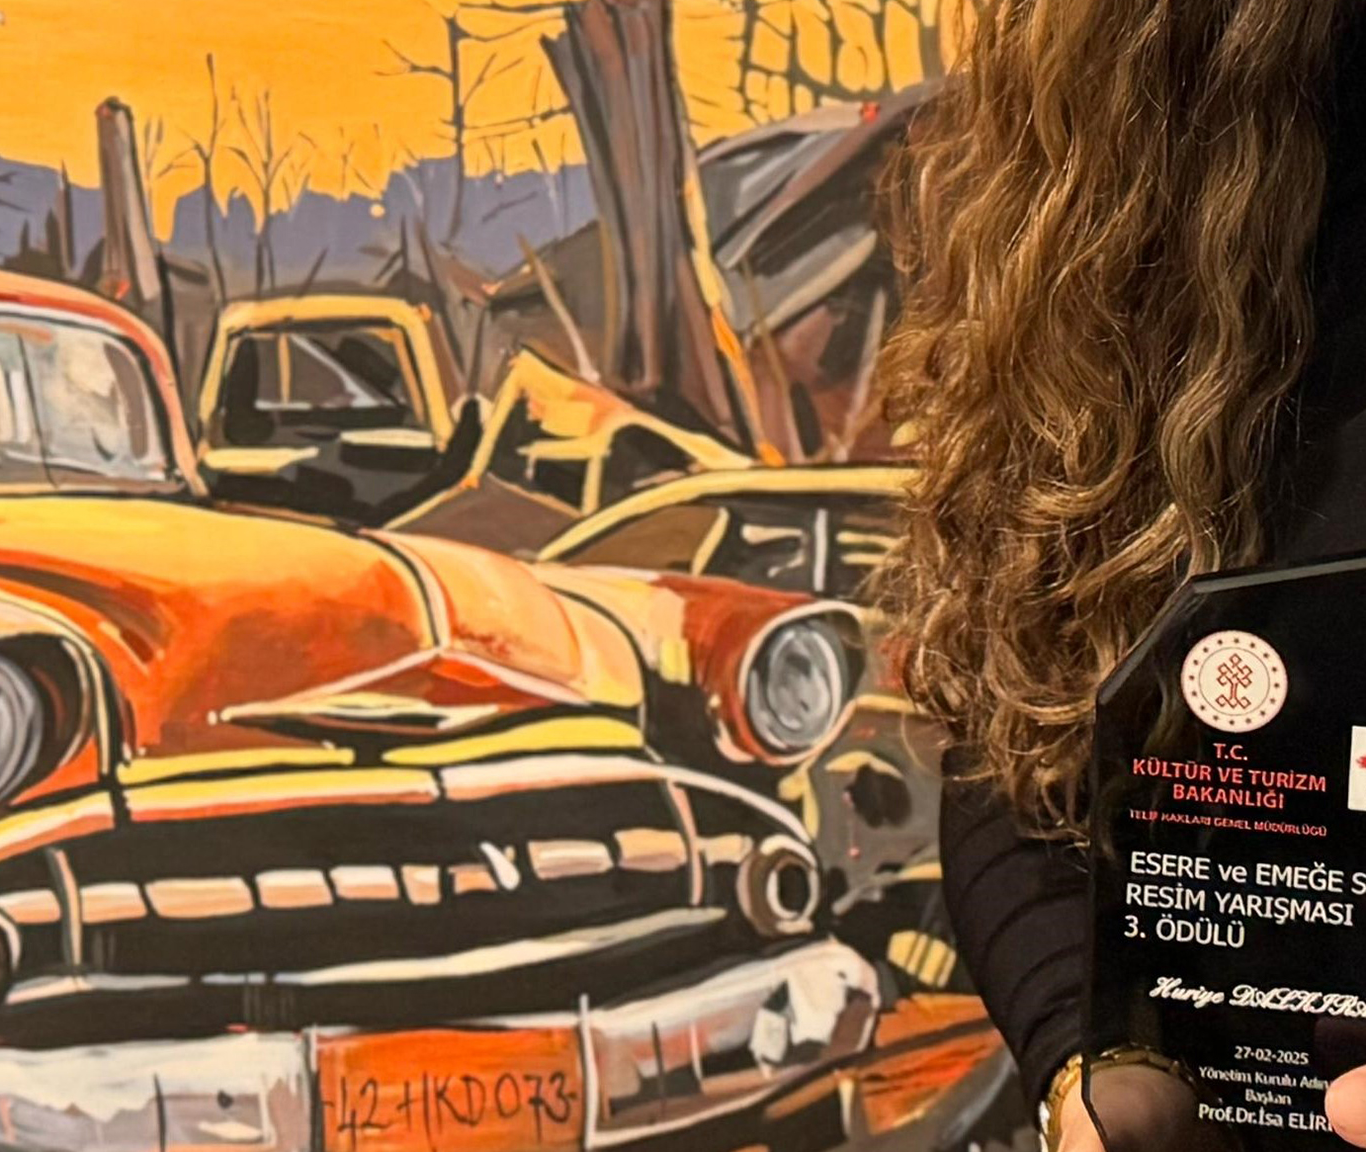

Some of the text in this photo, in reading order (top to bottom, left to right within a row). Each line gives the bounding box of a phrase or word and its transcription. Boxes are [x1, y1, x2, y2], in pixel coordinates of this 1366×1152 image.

[1213, 742, 1248, 761] T.C.
[1133, 757, 1327, 792] KÜLTÜR VE TURİZM
[1173, 783, 1285, 809] BAKANLIĞI
[1214, 817, 1251, 831] GENEL
[1130, 851, 1211, 880] ESERE
[1218, 863, 1248, 883] ve
[1256, 861, 1344, 893] EMEĞE
[1126, 882, 1354, 927] RESİM YARIŞMASI
[1124, 913, 1245, 948] 3. ÖDÜLÜ
[1149, 976, 1225, 1009] Huriye
[1234, 1045, 1309, 1065] 27-02-2025
[1199, 1066, 1330, 1091] Yönetim Kurulu Adın
